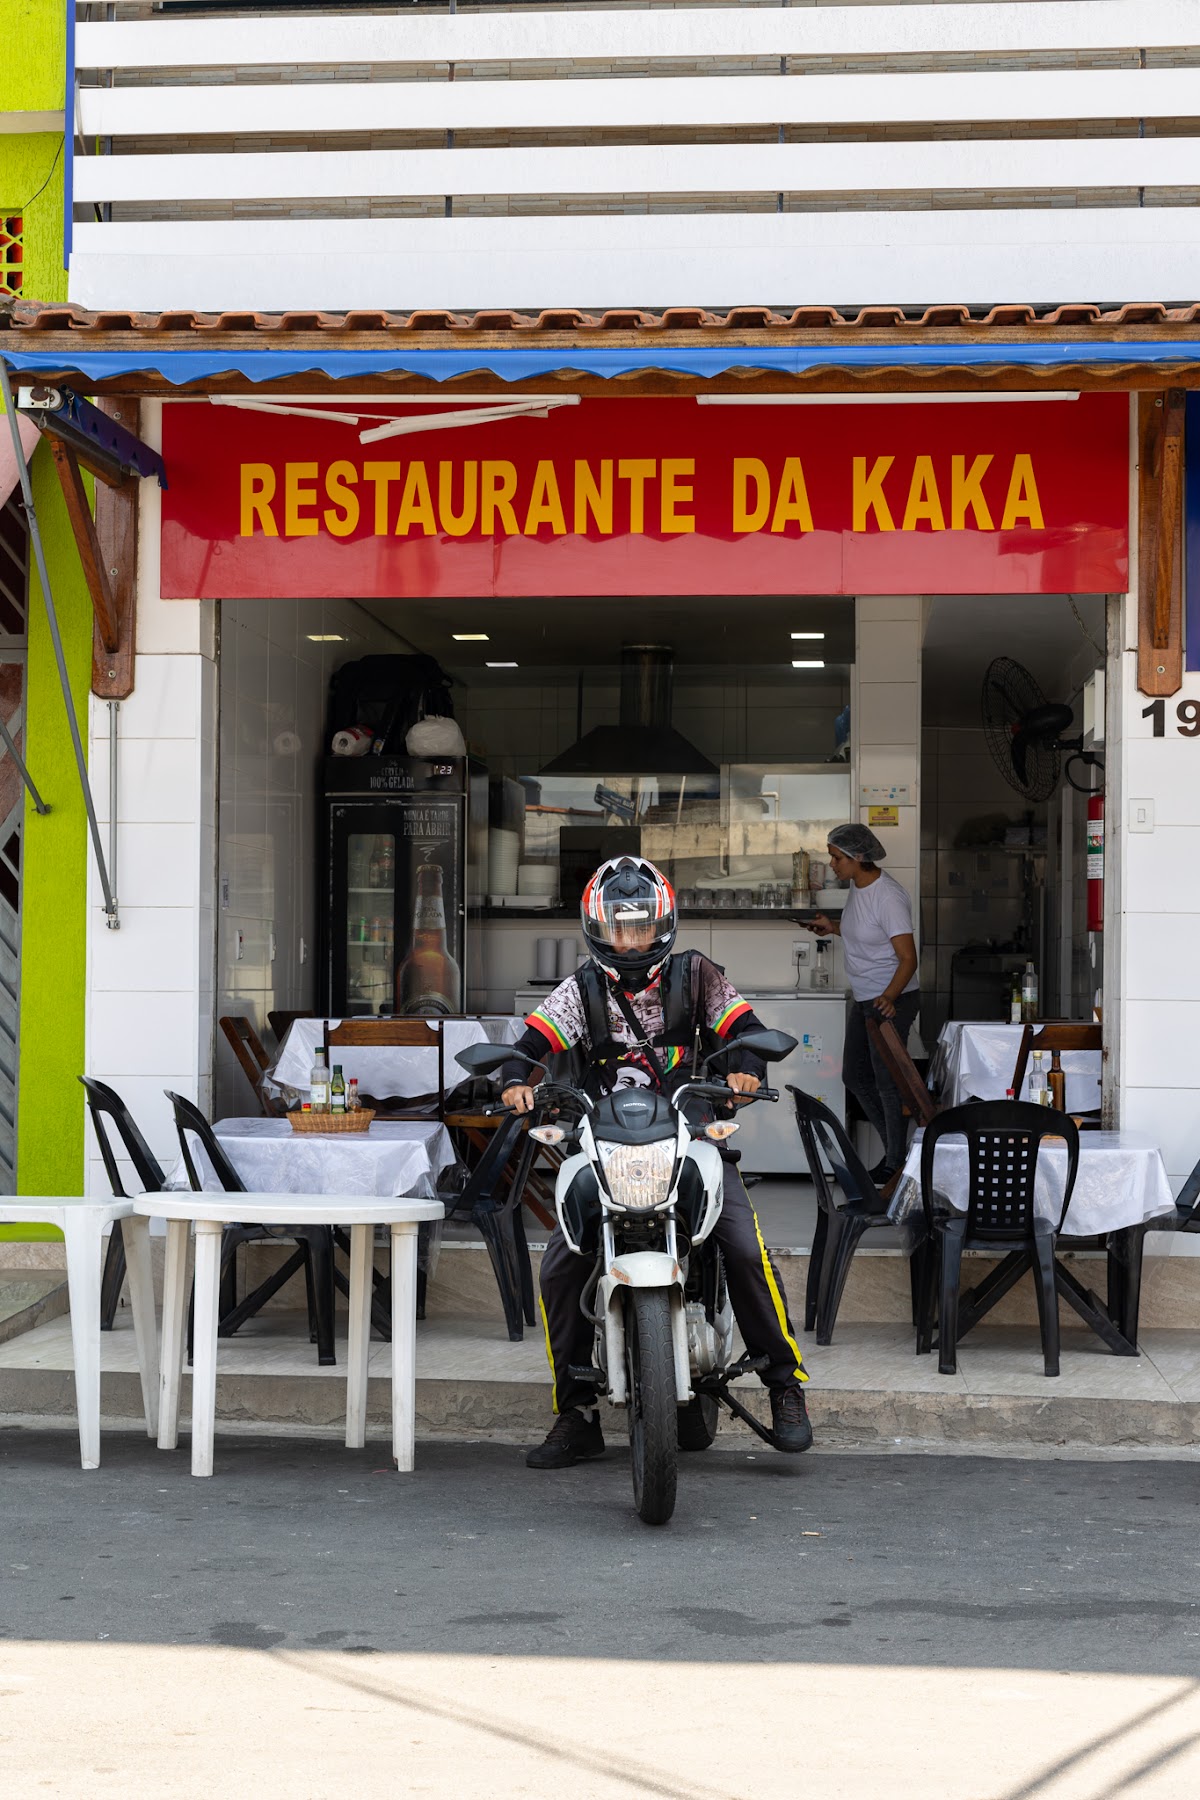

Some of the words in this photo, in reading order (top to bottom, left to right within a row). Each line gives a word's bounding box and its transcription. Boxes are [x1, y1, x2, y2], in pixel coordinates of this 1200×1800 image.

[240, 458, 696, 538] RESTAURANTE
[733, 457, 815, 534] DA
[852, 454, 1046, 533] KAKA
[1142, 699, 1200, 738] 19
[370, 777, 388, 789] 100%
[388, 776, 415, 788] GELADA
[403, 810, 424, 821] NUNCA
[403, 822, 424, 836] PARA
[425, 822, 451, 836] ABRIR
